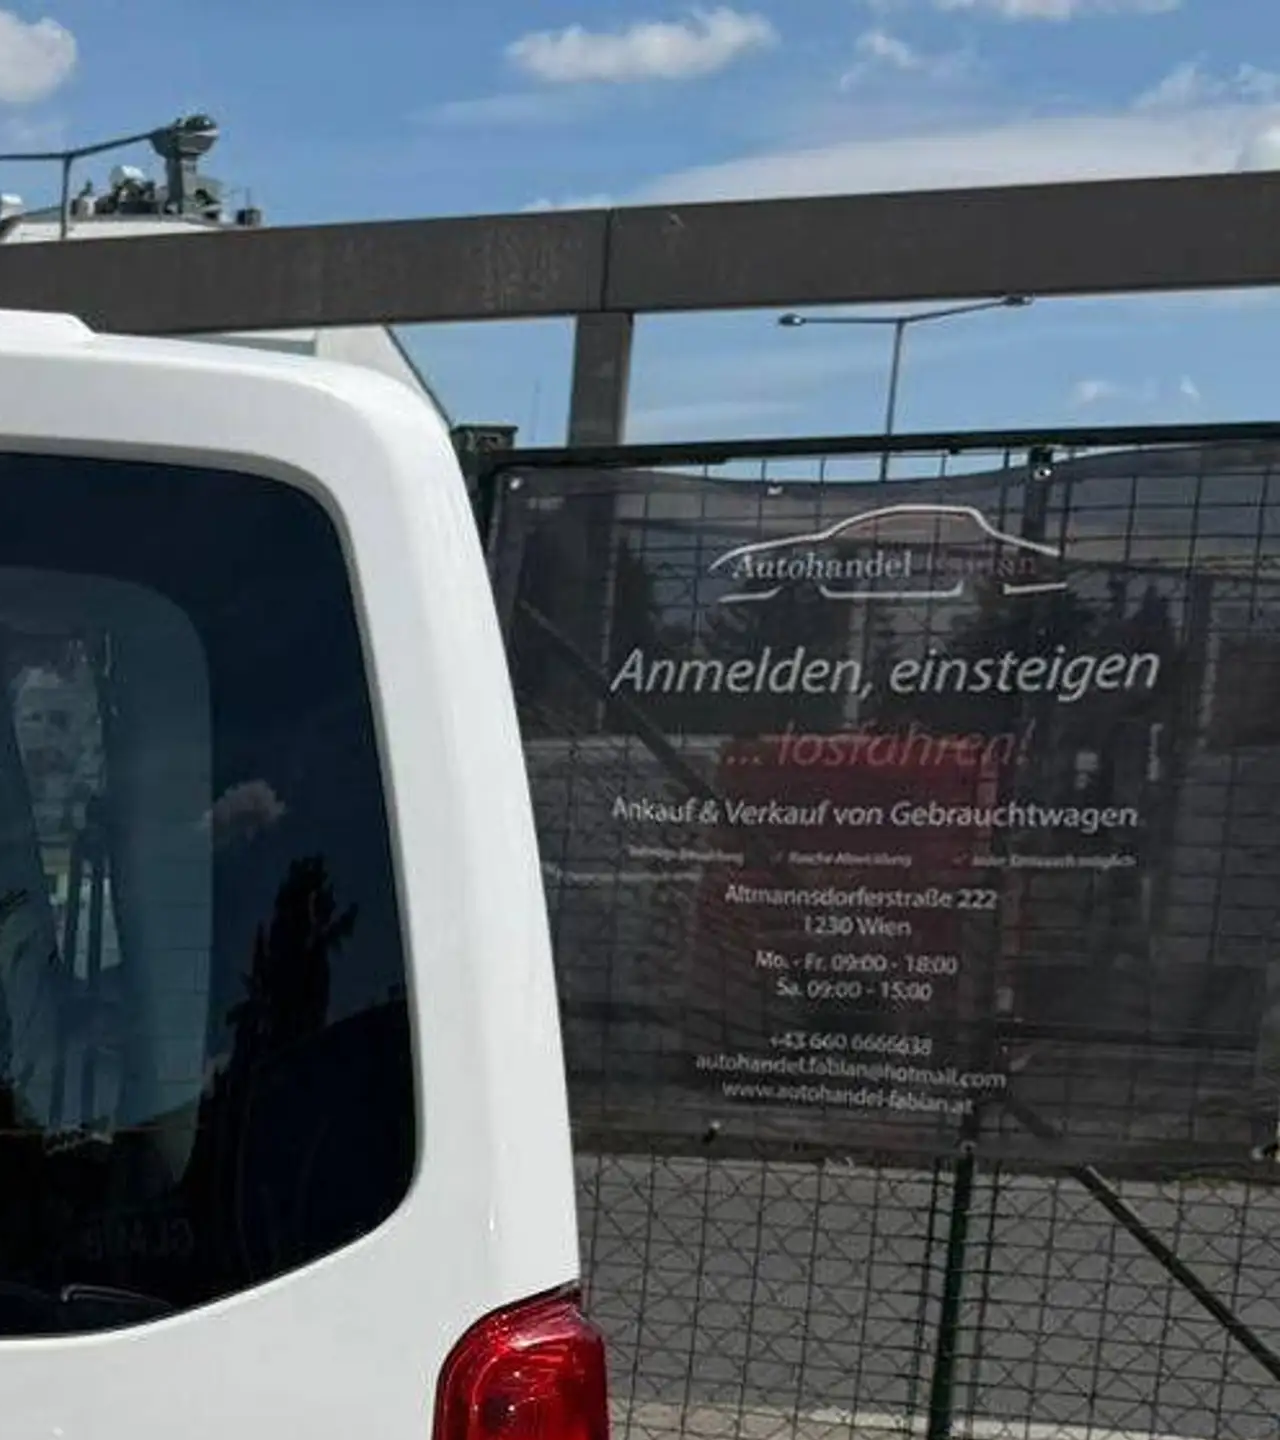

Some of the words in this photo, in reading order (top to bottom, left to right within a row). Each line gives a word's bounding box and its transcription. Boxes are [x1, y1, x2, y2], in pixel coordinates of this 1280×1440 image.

[732, 549, 912, 580] Autohandel
[610, 646, 872, 700] Anmelden,
[889, 646, 1160, 702] einsteigen
[776, 717, 1036, 767] losfahren!
[611, 796, 697, 823] Ankauf
[699, 800, 720, 824] &
[724, 798, 831, 826] Verkauf
[833, 804, 883, 826] von
[890, 800, 1140, 835] Gebrauchtwagen
[957, 889, 998, 910] 222
[804, 915, 853, 936] 1230
[856, 916, 913, 938] Wien
[830, 953, 888, 973] 09:00
